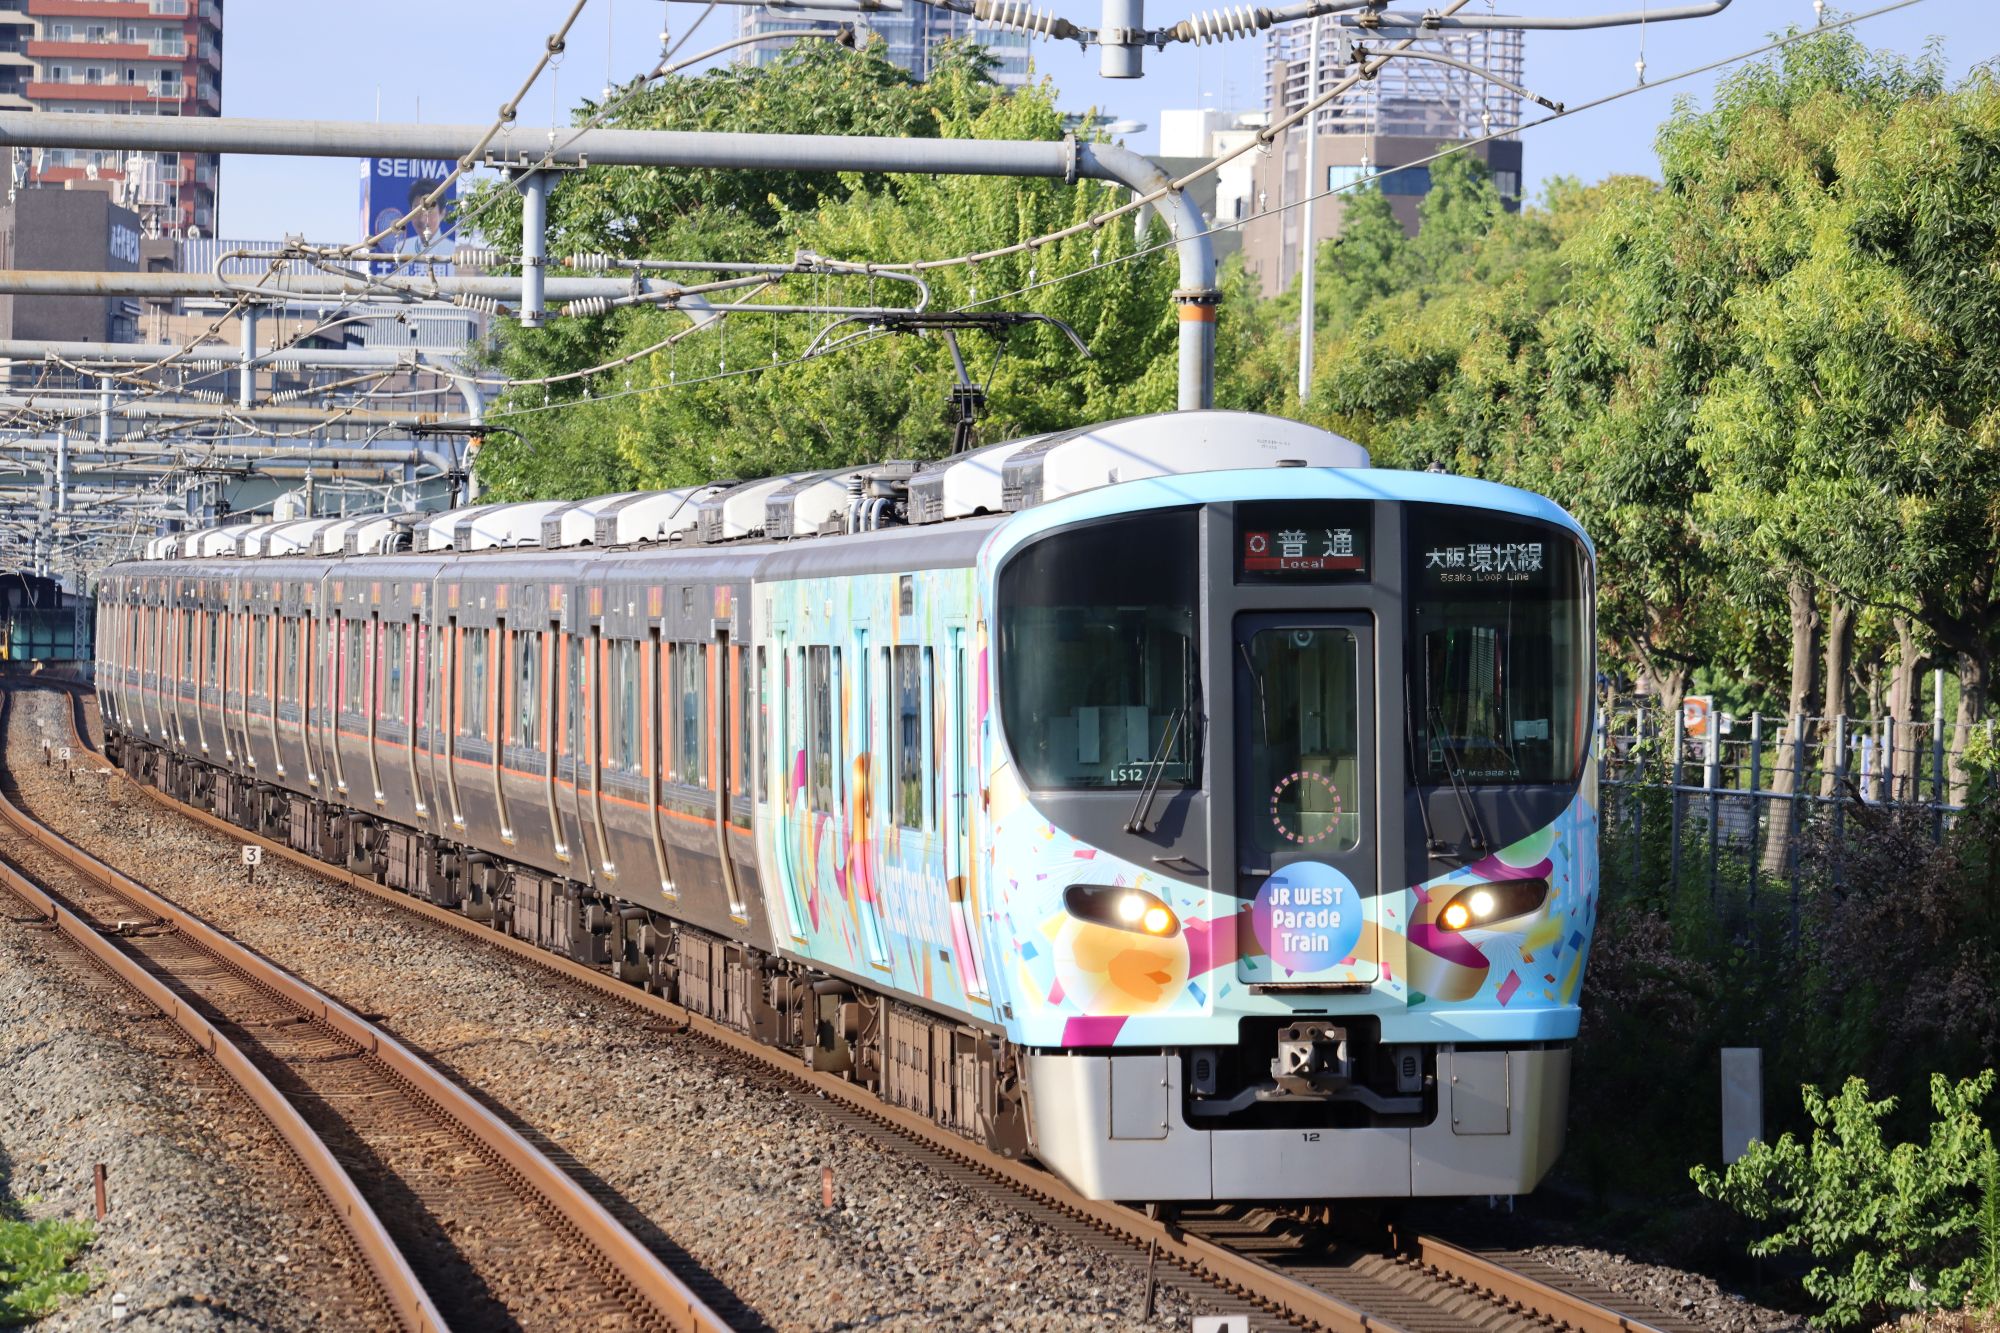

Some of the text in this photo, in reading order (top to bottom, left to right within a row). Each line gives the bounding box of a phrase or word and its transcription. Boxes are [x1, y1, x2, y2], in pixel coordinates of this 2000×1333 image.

[377, 159, 450, 179] SEIWA
[1277, 529, 1354, 557] 普通
[1280, 558, 1324, 569] Local
[1425, 543, 1543, 572] 大阪環状線
[1476, 573, 1501, 582] Loop
[1507, 572, 1529, 581] Line
[61, 748, 68, 758] 2
[1111, 769, 1143, 781] LS12
[246, 847, 257, 862] 3
[1268, 888, 1343, 906] JR WEST
[1272, 908, 1341, 929] Parade
[1281, 932, 1329, 952] Train
[1302, 1132, 1321, 1142] 12
